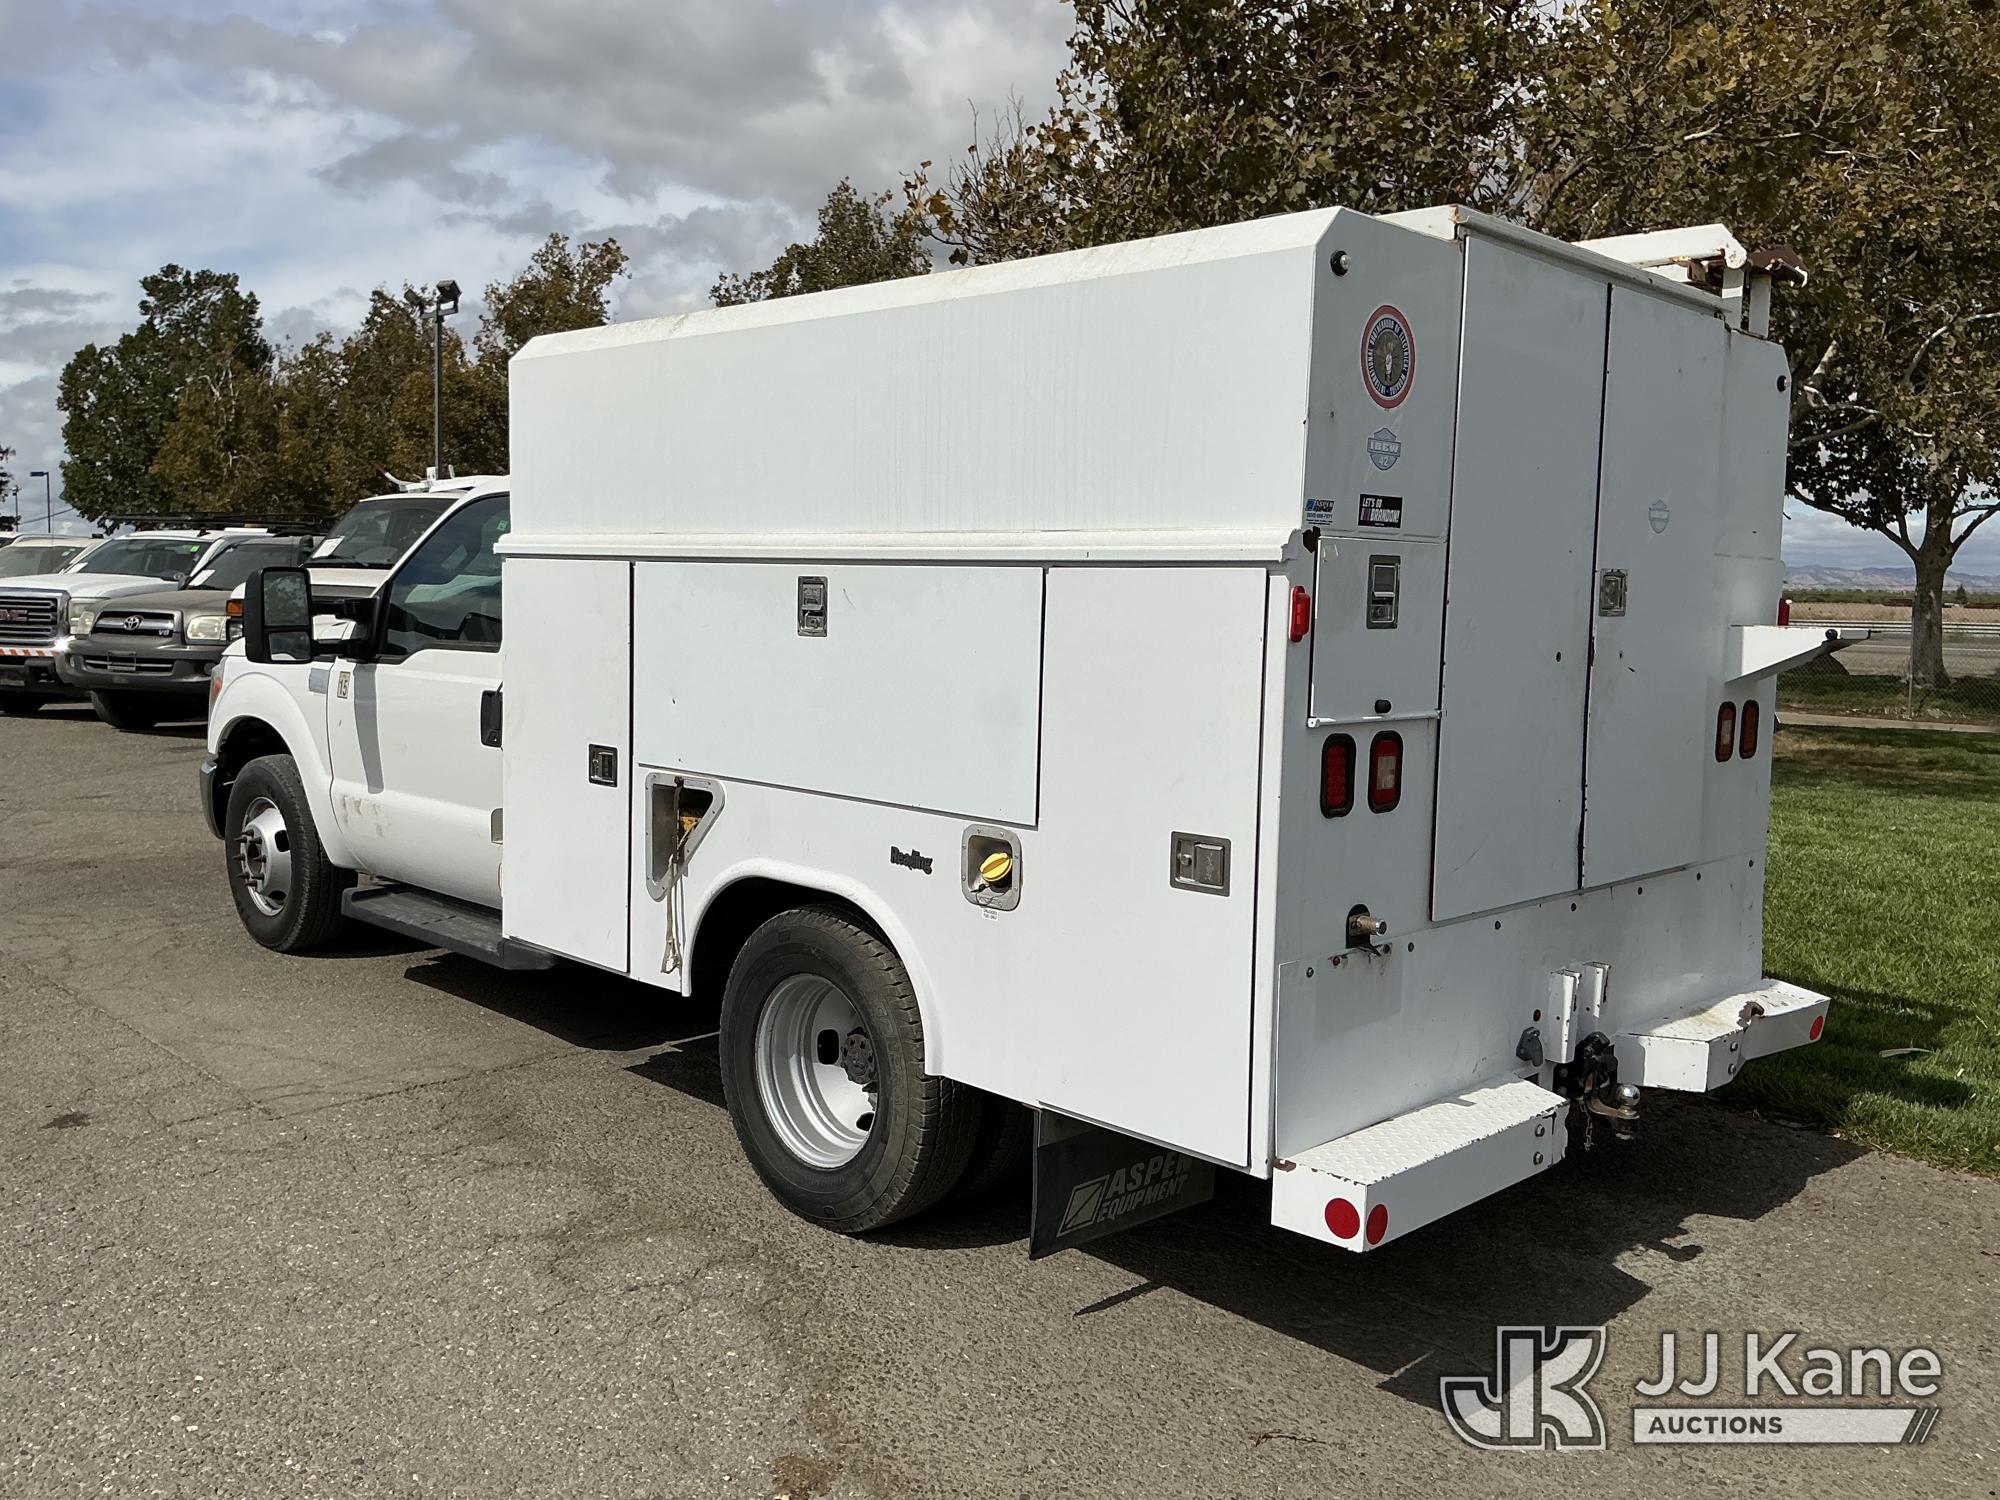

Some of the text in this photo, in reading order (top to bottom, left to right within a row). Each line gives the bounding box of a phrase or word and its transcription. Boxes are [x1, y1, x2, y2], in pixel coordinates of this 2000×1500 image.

[1370, 441, 1398, 453] IBEW
[1362, 498, 1383, 508] LET'S GO
[1370, 508, 1400, 523] BRANDON!
[339, 679, 349, 696] 15
[890, 845, 933, 875] Reading
[1105, 1151, 1193, 1199] ASPEN
[1096, 1173, 1190, 1224] EQUIPMENT
